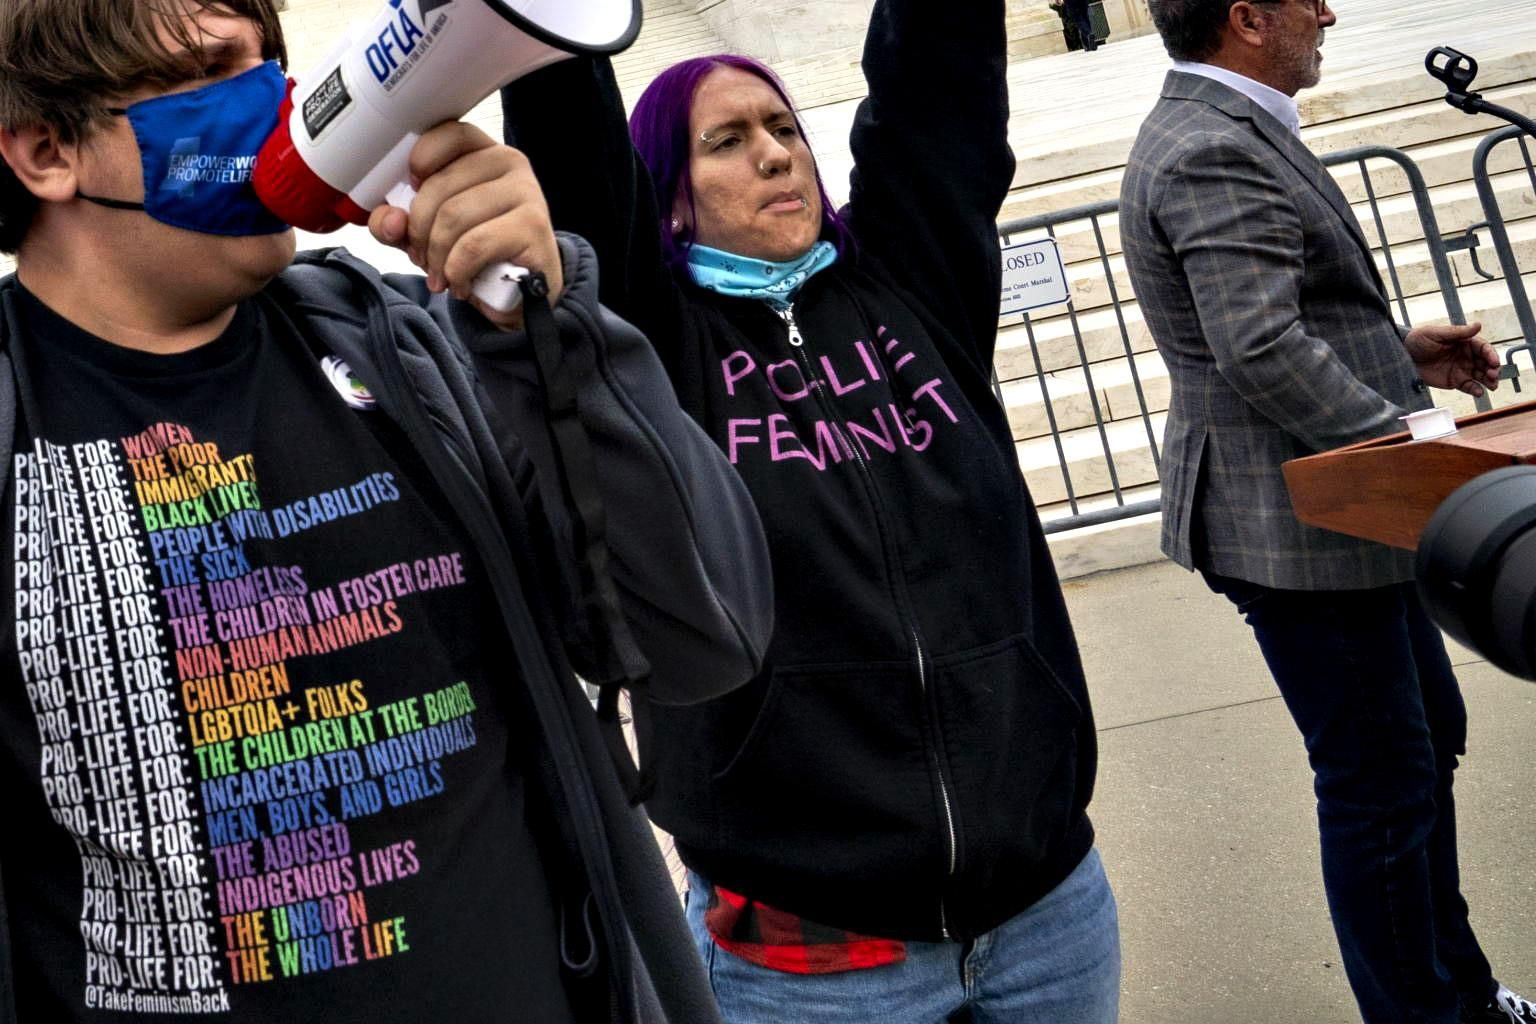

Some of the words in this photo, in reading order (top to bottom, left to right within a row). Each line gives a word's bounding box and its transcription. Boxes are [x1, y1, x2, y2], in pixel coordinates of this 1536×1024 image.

[365, 8, 424, 83] DFLA
[1002, 251, 1045, 272] OSED
[73, 439, 121, 468] FOR:
[121, 422, 194, 459] WOMEN
[79, 464, 127, 493] FOR:
[128, 455, 170, 480] THE
[168, 442, 221, 474] POOR
[85, 488, 134, 518] FOR:
[134, 453, 256, 506] IMMIGRANTS
[91, 512, 140, 543] FOR:
[141, 497, 212, 533] BLACK
[208, 480, 261, 518] LIVES
[97, 537, 148, 570] FOR:
[149, 521, 229, 559] PEOPLE
[225, 509, 274, 543] WITH
[272, 472, 400, 538] DISABILITIES
[15, 572, 102, 620] PRO-LIFE
[104, 564, 155, 598] FOR:
[155, 555, 200, 587] THE
[201, 546, 251, 582] SICK
[16, 602, 107, 651] PRO-LIFE
[109, 593, 161, 629] FOR:
[161, 584, 206, 618] THE
[18, 633, 113, 682] PRO-LIFE
[115, 624, 167, 661] FOR:
[168, 613, 213, 649] THE
[215, 595, 312, 642] CHILDREN
[311, 587, 339, 621] IN
[339, 562, 416, 614] FOSTER
[414, 552, 466, 591] CARE
[26, 665, 119, 713] PRO-LIFE
[121, 656, 173, 694] FOR:
[175, 626, 309, 681] NON-HUMAN
[309, 600, 404, 655] ANIMALS
[35, 697, 125, 744] PRO-LIFE
[127, 688, 179, 727] FOR:
[182, 662, 291, 713] CHILDREN
[41, 731, 131, 775] PRO-LIFE
[133, 721, 186, 760] FOR:
[188, 699, 300, 747] LGBTQIA+
[305, 679, 368, 721] FOLKS
[41, 763, 137, 808] PRO-LIFE
[140, 754, 192, 793] FOR:
[194, 740, 240, 779] THE
[242, 718, 348, 770] CHILDREN
[349, 710, 376, 748] AT
[377, 697, 423, 736] THE
[423, 680, 477, 726] BORDER
[145, 787, 198, 826] FOR:
[200, 749, 364, 813] INCARCERATED
[364, 715, 477, 777] INDIVIDUALS
[150, 820, 203, 858] FOR:
[340, 780, 383, 820] AND
[384, 761, 445, 807] GIRLS
[81, 856, 156, 890] PRO-LIFE
[154, 853, 208, 889] FOR:
[211, 840, 256, 879] THE
[262, 822, 351, 872] ABUSED
[81, 887, 160, 923] PRO-LIFE
[162, 887, 213, 923] FOR:
[217, 856, 357, 916] INDIGENOUS
[359, 839, 420, 887] LIVES
[80, 920, 166, 957] PRO-LIFE
[167, 921, 218, 956] FOR:
[220, 911, 268, 950] THE
[271, 890, 368, 943] UNBORN
[86, 951, 168, 990] PRO-LIFE
[173, 955, 223, 990] FOR:
[226, 945, 273, 984] THE
[276, 929, 359, 977] WHOLE
[361, 916, 409, 960] LIFE
[85, 985, 230, 1014] @TakeFeminismBack
